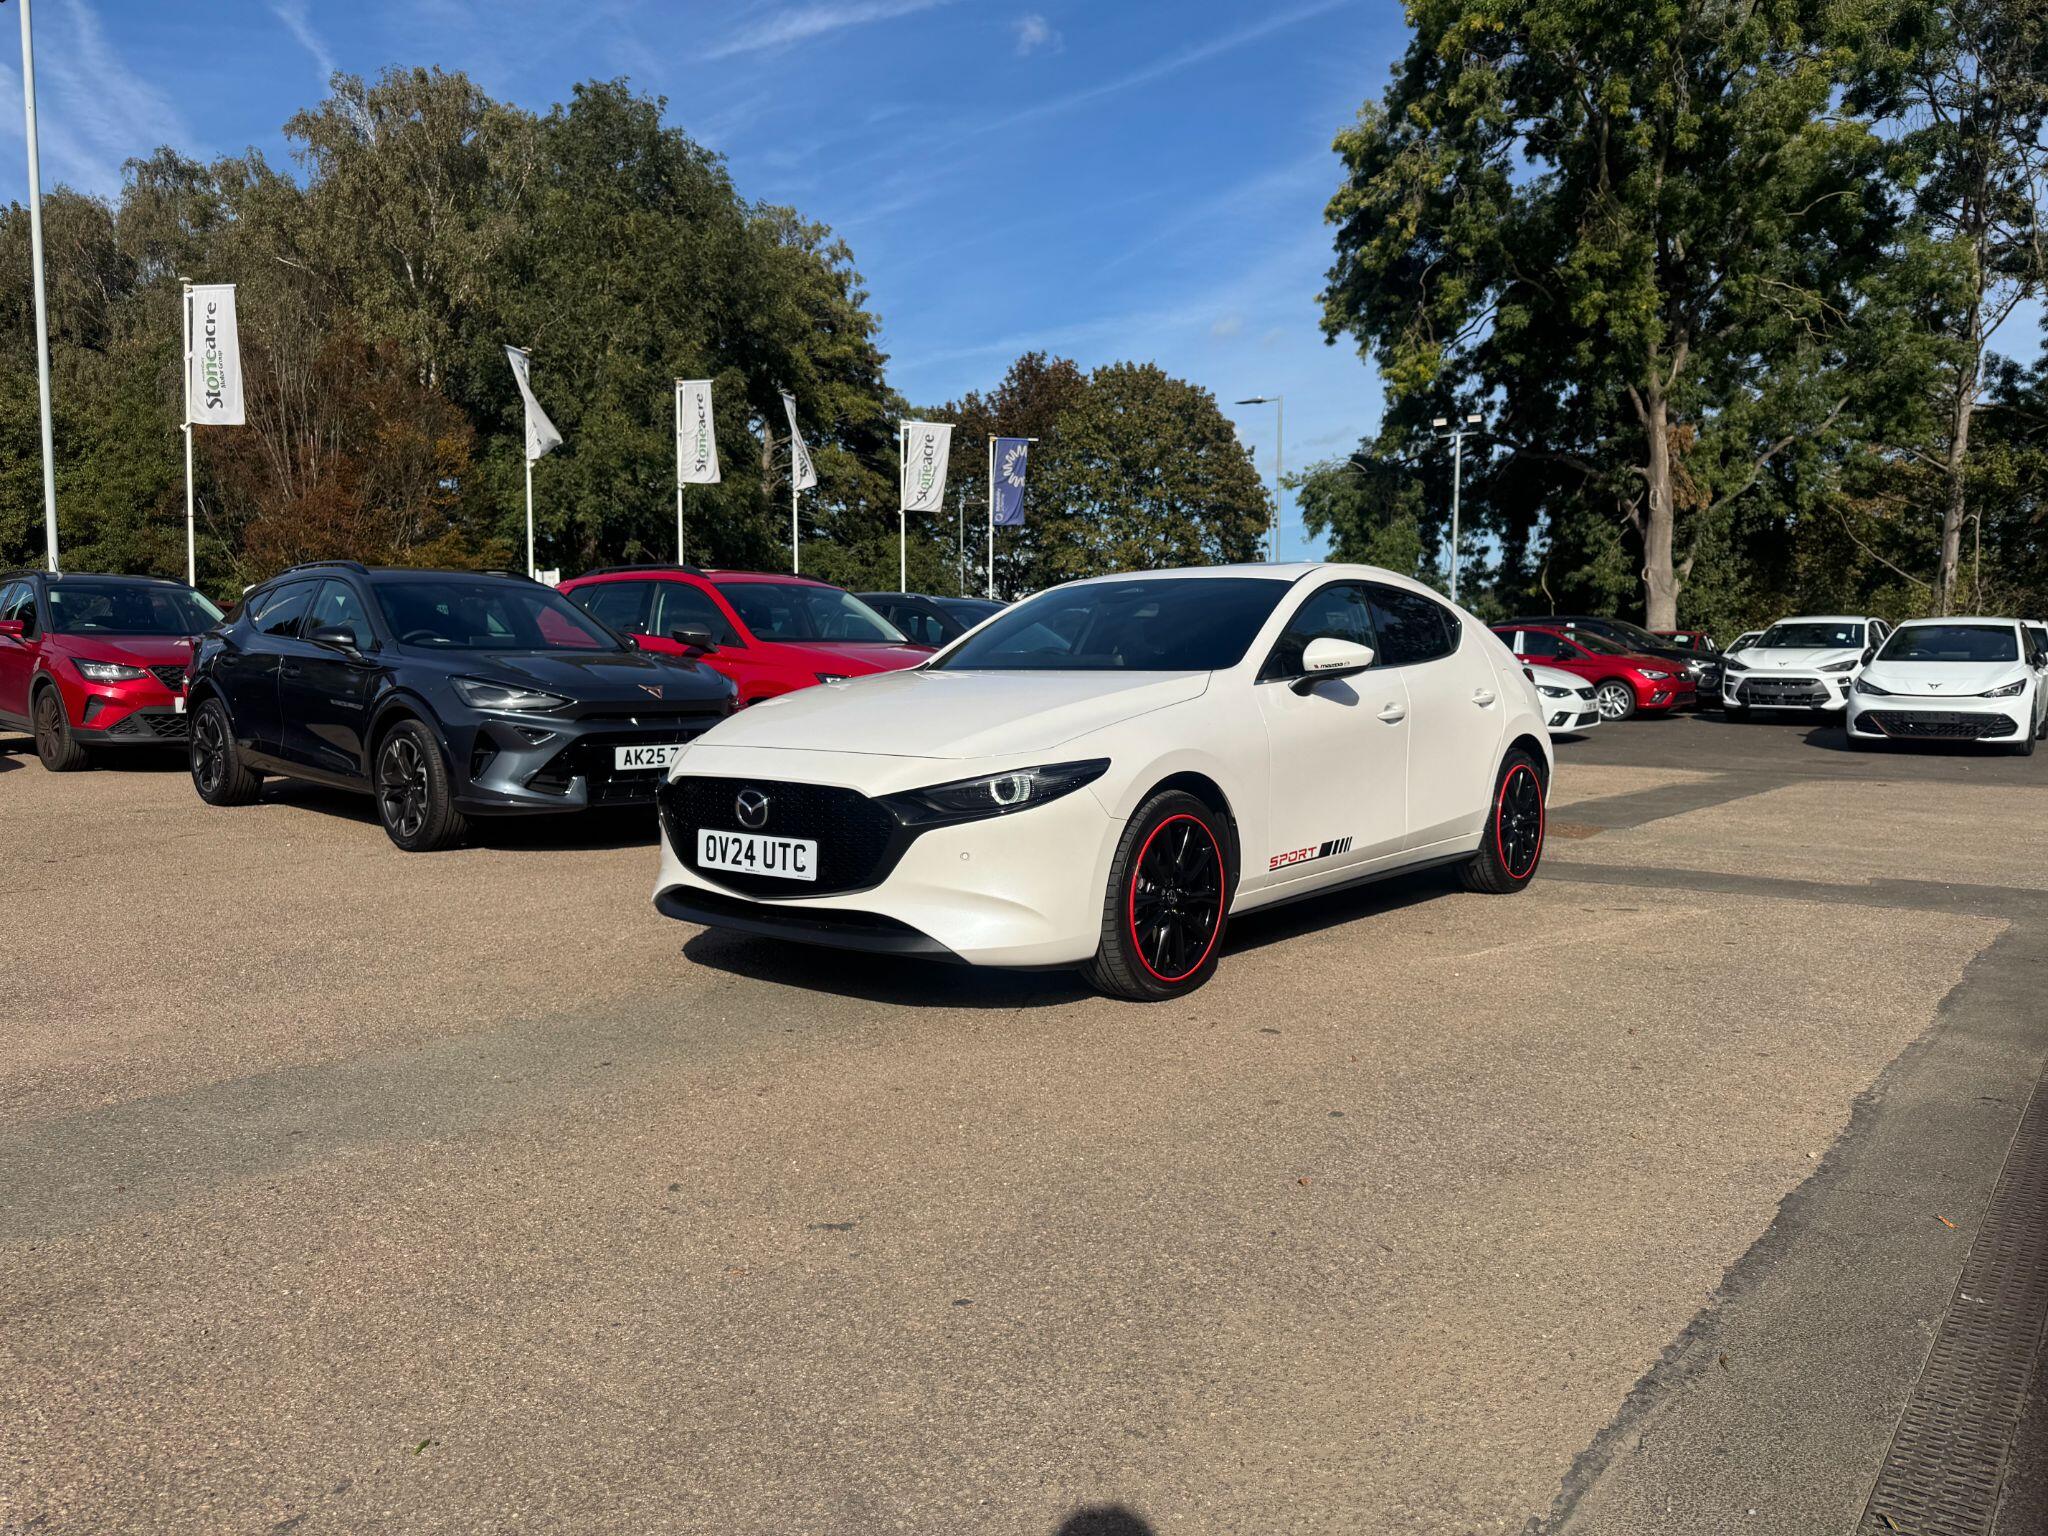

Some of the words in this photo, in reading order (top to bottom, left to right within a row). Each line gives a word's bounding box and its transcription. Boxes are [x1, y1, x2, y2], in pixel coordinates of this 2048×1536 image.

[205, 302, 223, 409] Stoneacre
[219, 370, 227, 389] Motor
[695, 393, 706, 472] Stoneacre
[917, 434, 934, 502] Stoneacre
[624, 748, 666, 766] AK25
[706, 834, 756, 867] OV24
[763, 841, 806, 872] UTC
[1269, 846, 1317, 868] SPORT
